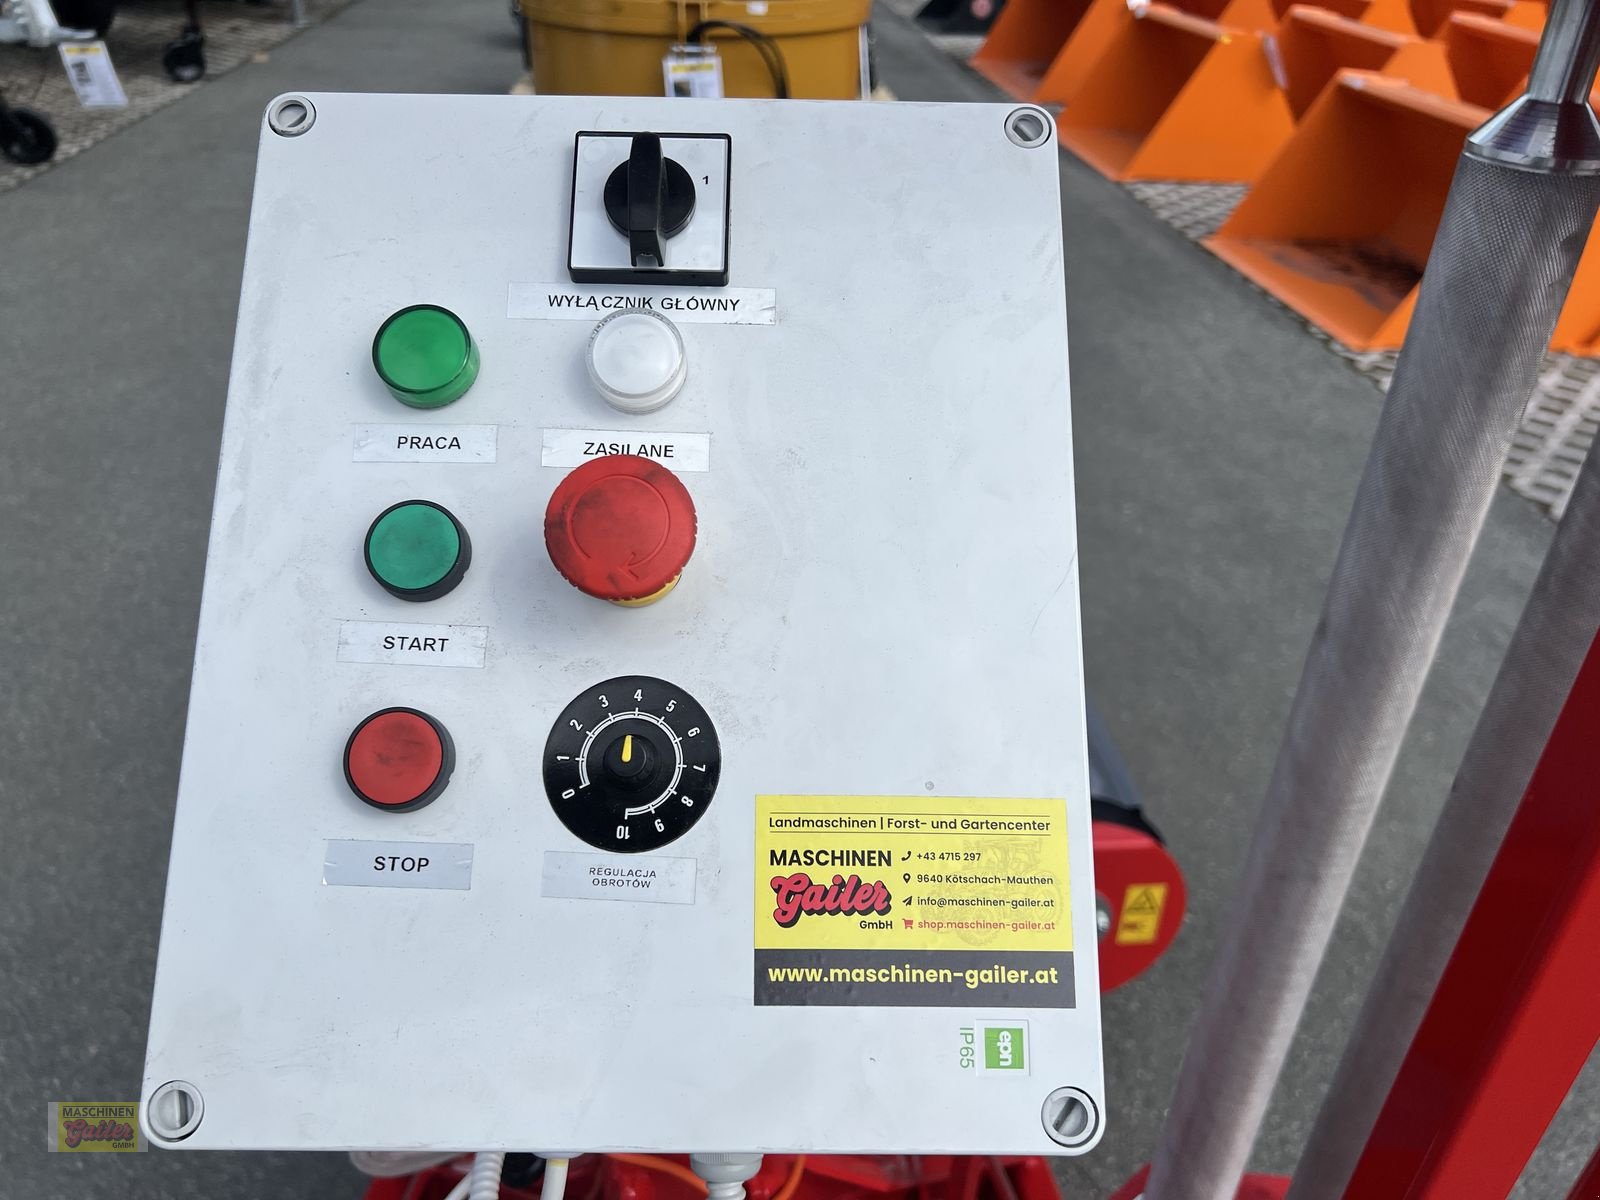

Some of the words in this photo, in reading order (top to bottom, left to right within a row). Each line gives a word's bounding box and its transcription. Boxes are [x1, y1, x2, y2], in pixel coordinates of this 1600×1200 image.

[702, 175, 709, 185] 1
[660, 294, 741, 312] GŁÓWNY
[396, 436, 462, 450] PRACA
[583, 442, 675, 458] ZASILANE
[382, 635, 450, 653] START
[598, 694, 610, 708] 3
[633, 689, 643, 702] 4
[665, 699, 677, 713] 5
[569, 718, 584, 731] 2
[687, 726, 700, 737] 6
[556, 754, 570, 762] 1
[692, 763, 706, 773] 7
[561, 788, 576, 800] 0
[681, 795, 694, 808] 8
[654, 818, 666, 833] 9
[769, 816, 877, 830] Landmaschinen
[887, 817, 928, 831] Forst-
[931, 818, 958, 831] und
[960, 819, 1051, 832] Gartencenter
[615, 825, 631, 840] 10
[769, 849, 893, 867] MASCHINEN
[916, 852, 936, 861] +43
[938, 852, 961, 861] 4715
[963, 852, 982, 861] 297
[373, 855, 430, 873] STOP
[588, 867, 657, 879] REGULACJA
[917, 874, 943, 883] 9640
[945, 874, 1054, 885] Kötschach-Mauthen
[592, 877, 651, 889] OBROTÓW
[770, 872, 892, 928] Gailer
[917, 896, 1055, 909] info@maschinen-gailer.at
[859, 920, 893, 930] GmbH
[918, 919, 1056, 932] shop.maschinen-gailer.at
[768, 965, 1059, 989] www.maschinen-gailer.at
[959, 1027, 975, 1069] IP65
